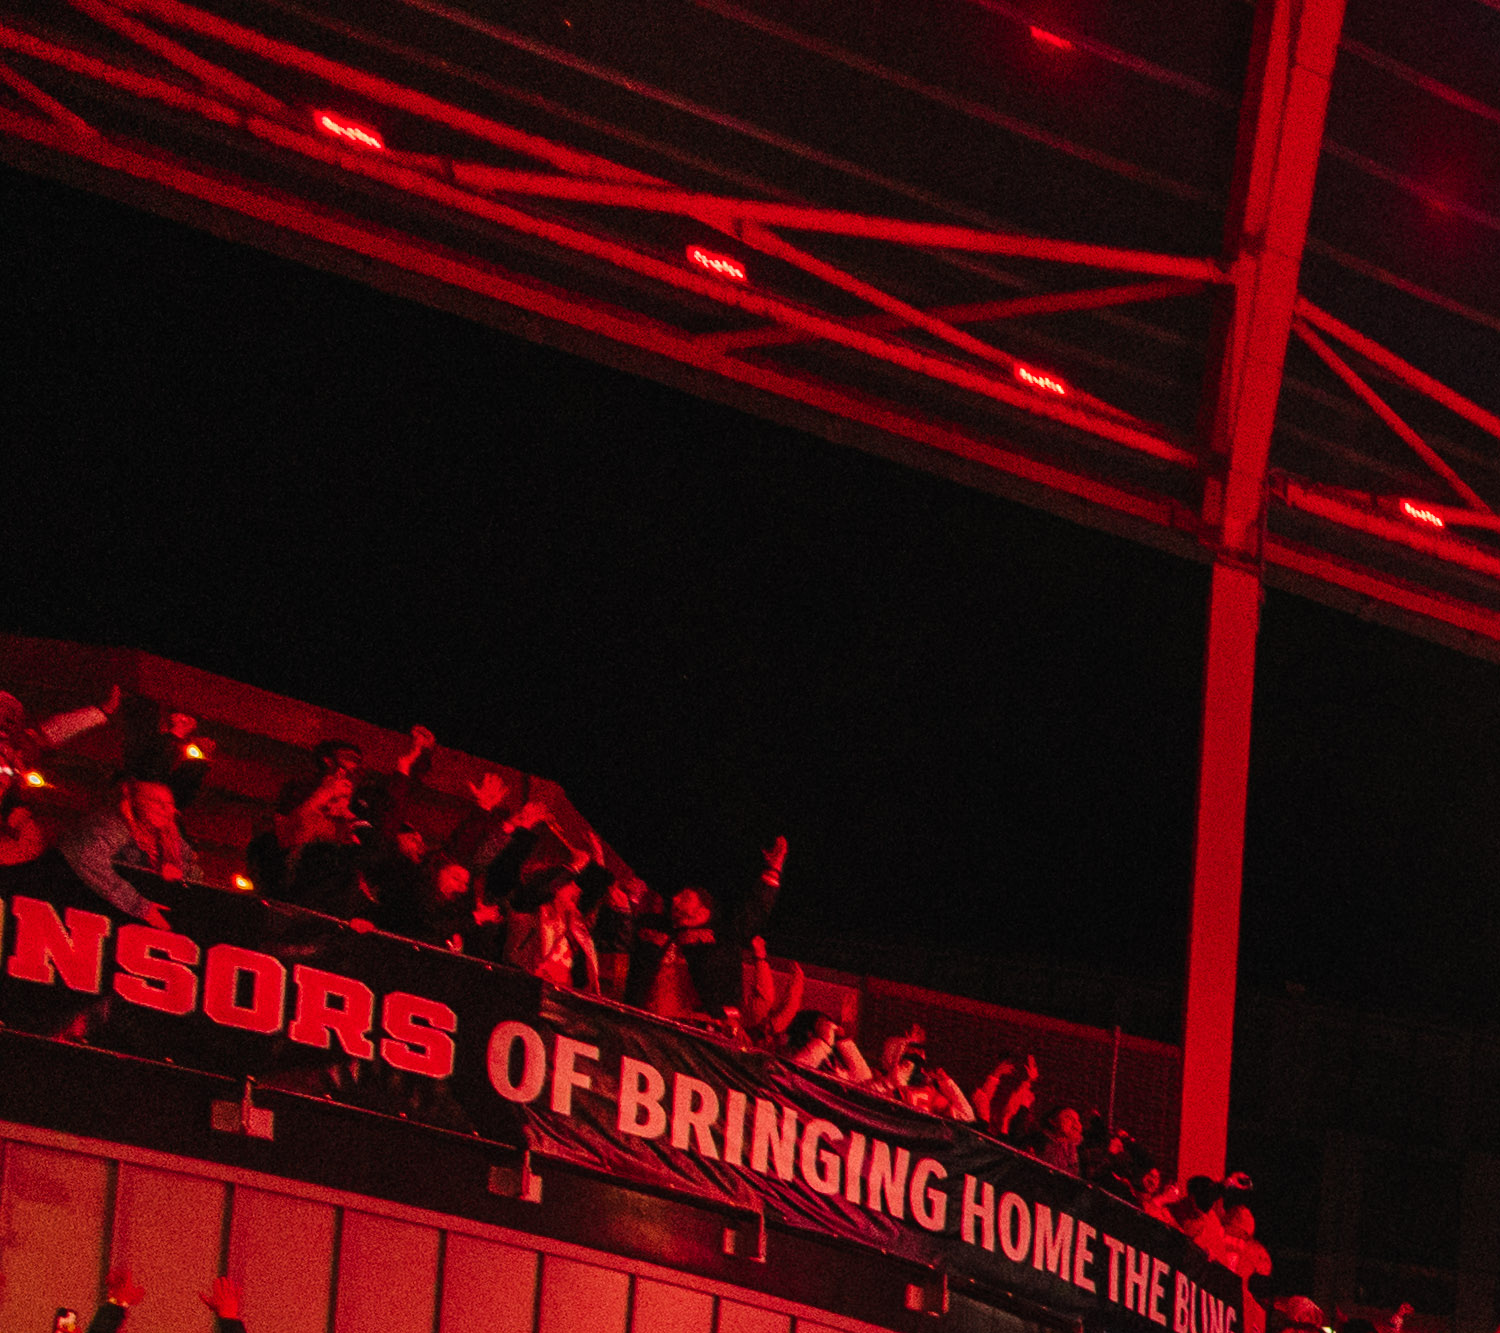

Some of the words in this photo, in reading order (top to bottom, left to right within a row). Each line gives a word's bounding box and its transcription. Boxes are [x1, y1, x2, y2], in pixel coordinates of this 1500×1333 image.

[6, 894, 458, 1079] NSORS
[487, 1019, 600, 1116] OF
[616, 1055, 949, 1232] BRINGING
[960, 1173, 1097, 1294] HOME
[1102, 1232, 1167, 1325] THE
